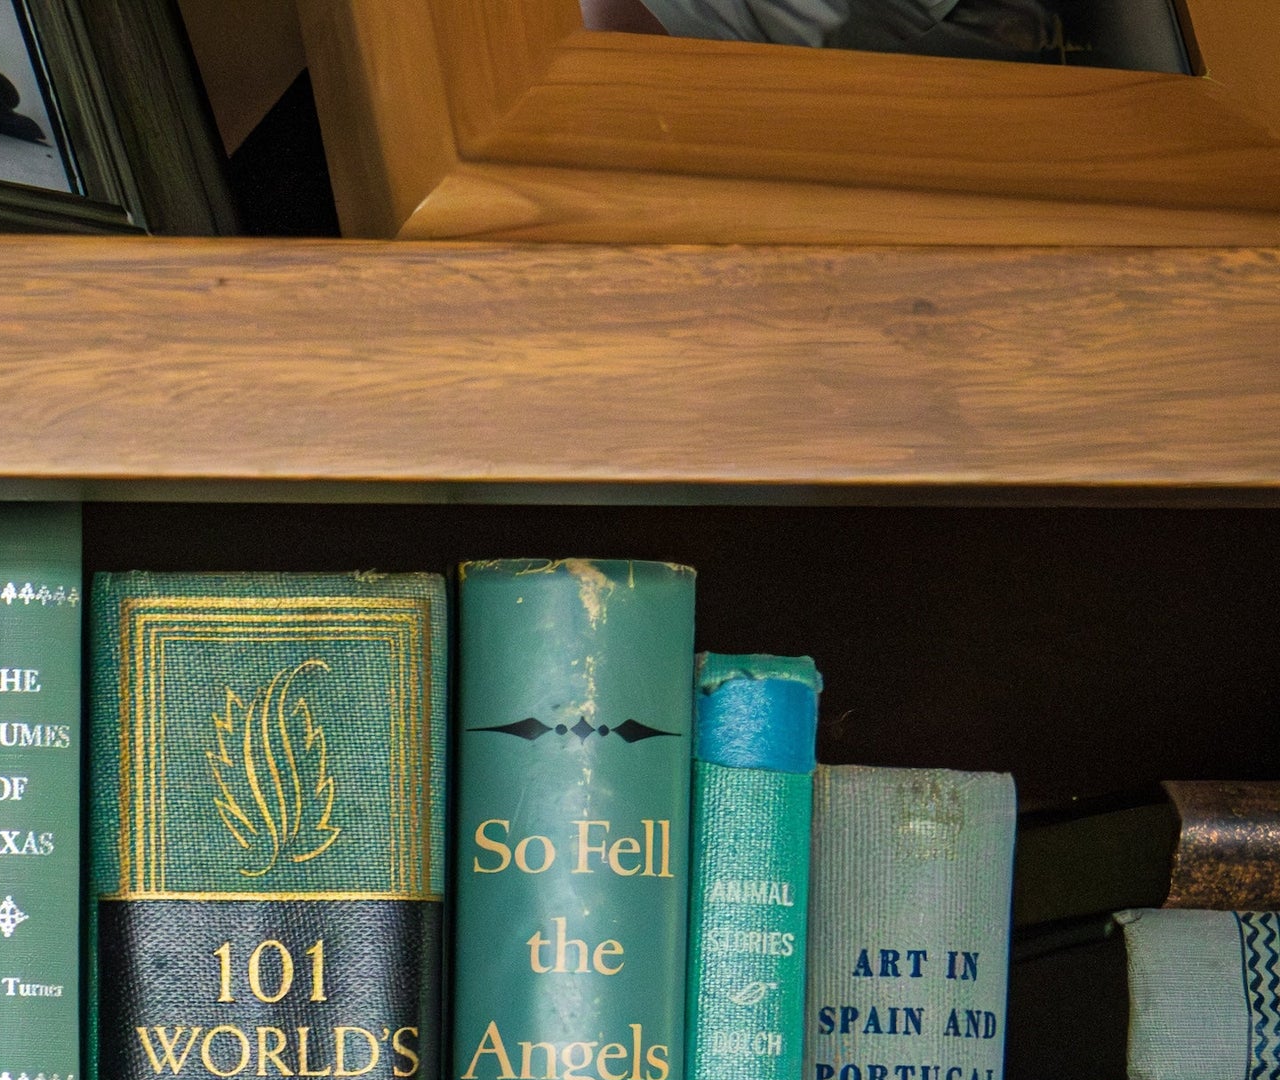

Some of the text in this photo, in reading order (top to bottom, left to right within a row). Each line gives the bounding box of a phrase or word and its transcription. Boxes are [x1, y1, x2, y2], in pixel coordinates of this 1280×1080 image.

[473, 819, 675, 878] So Fell
[710, 879, 794, 907] ANIMAL
[526, 916, 625, 976] the
[852, 948, 980, 981] ART IN
[1, 977, 65, 997] Turner
[213, 939, 328, 1003] 101
[817, 1005, 997, 1039] SPAIN AND
[135, 1024, 420, 1078] WORLD'S
